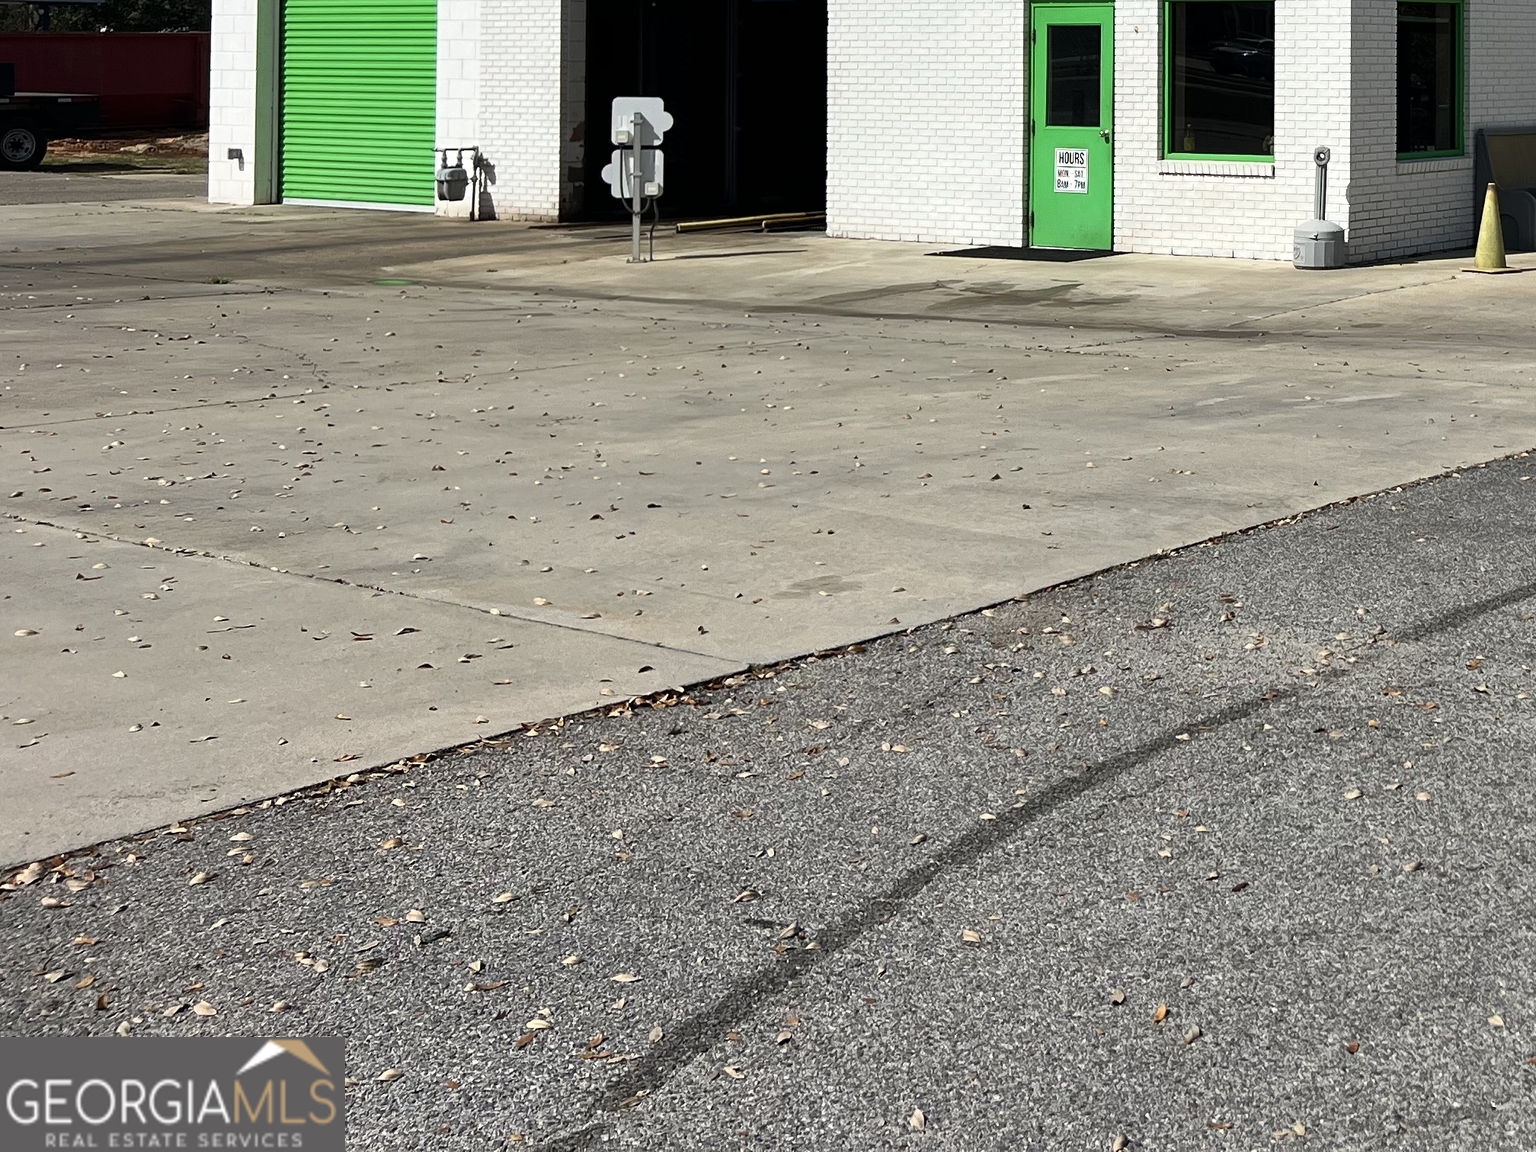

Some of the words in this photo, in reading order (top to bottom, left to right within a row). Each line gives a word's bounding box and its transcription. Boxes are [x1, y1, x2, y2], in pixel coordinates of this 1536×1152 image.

[1058, 151, 1085, 165] HOURS
[1057, 179, 1069, 189] 8AM
[1074, 179, 1086, 189] 7PM
